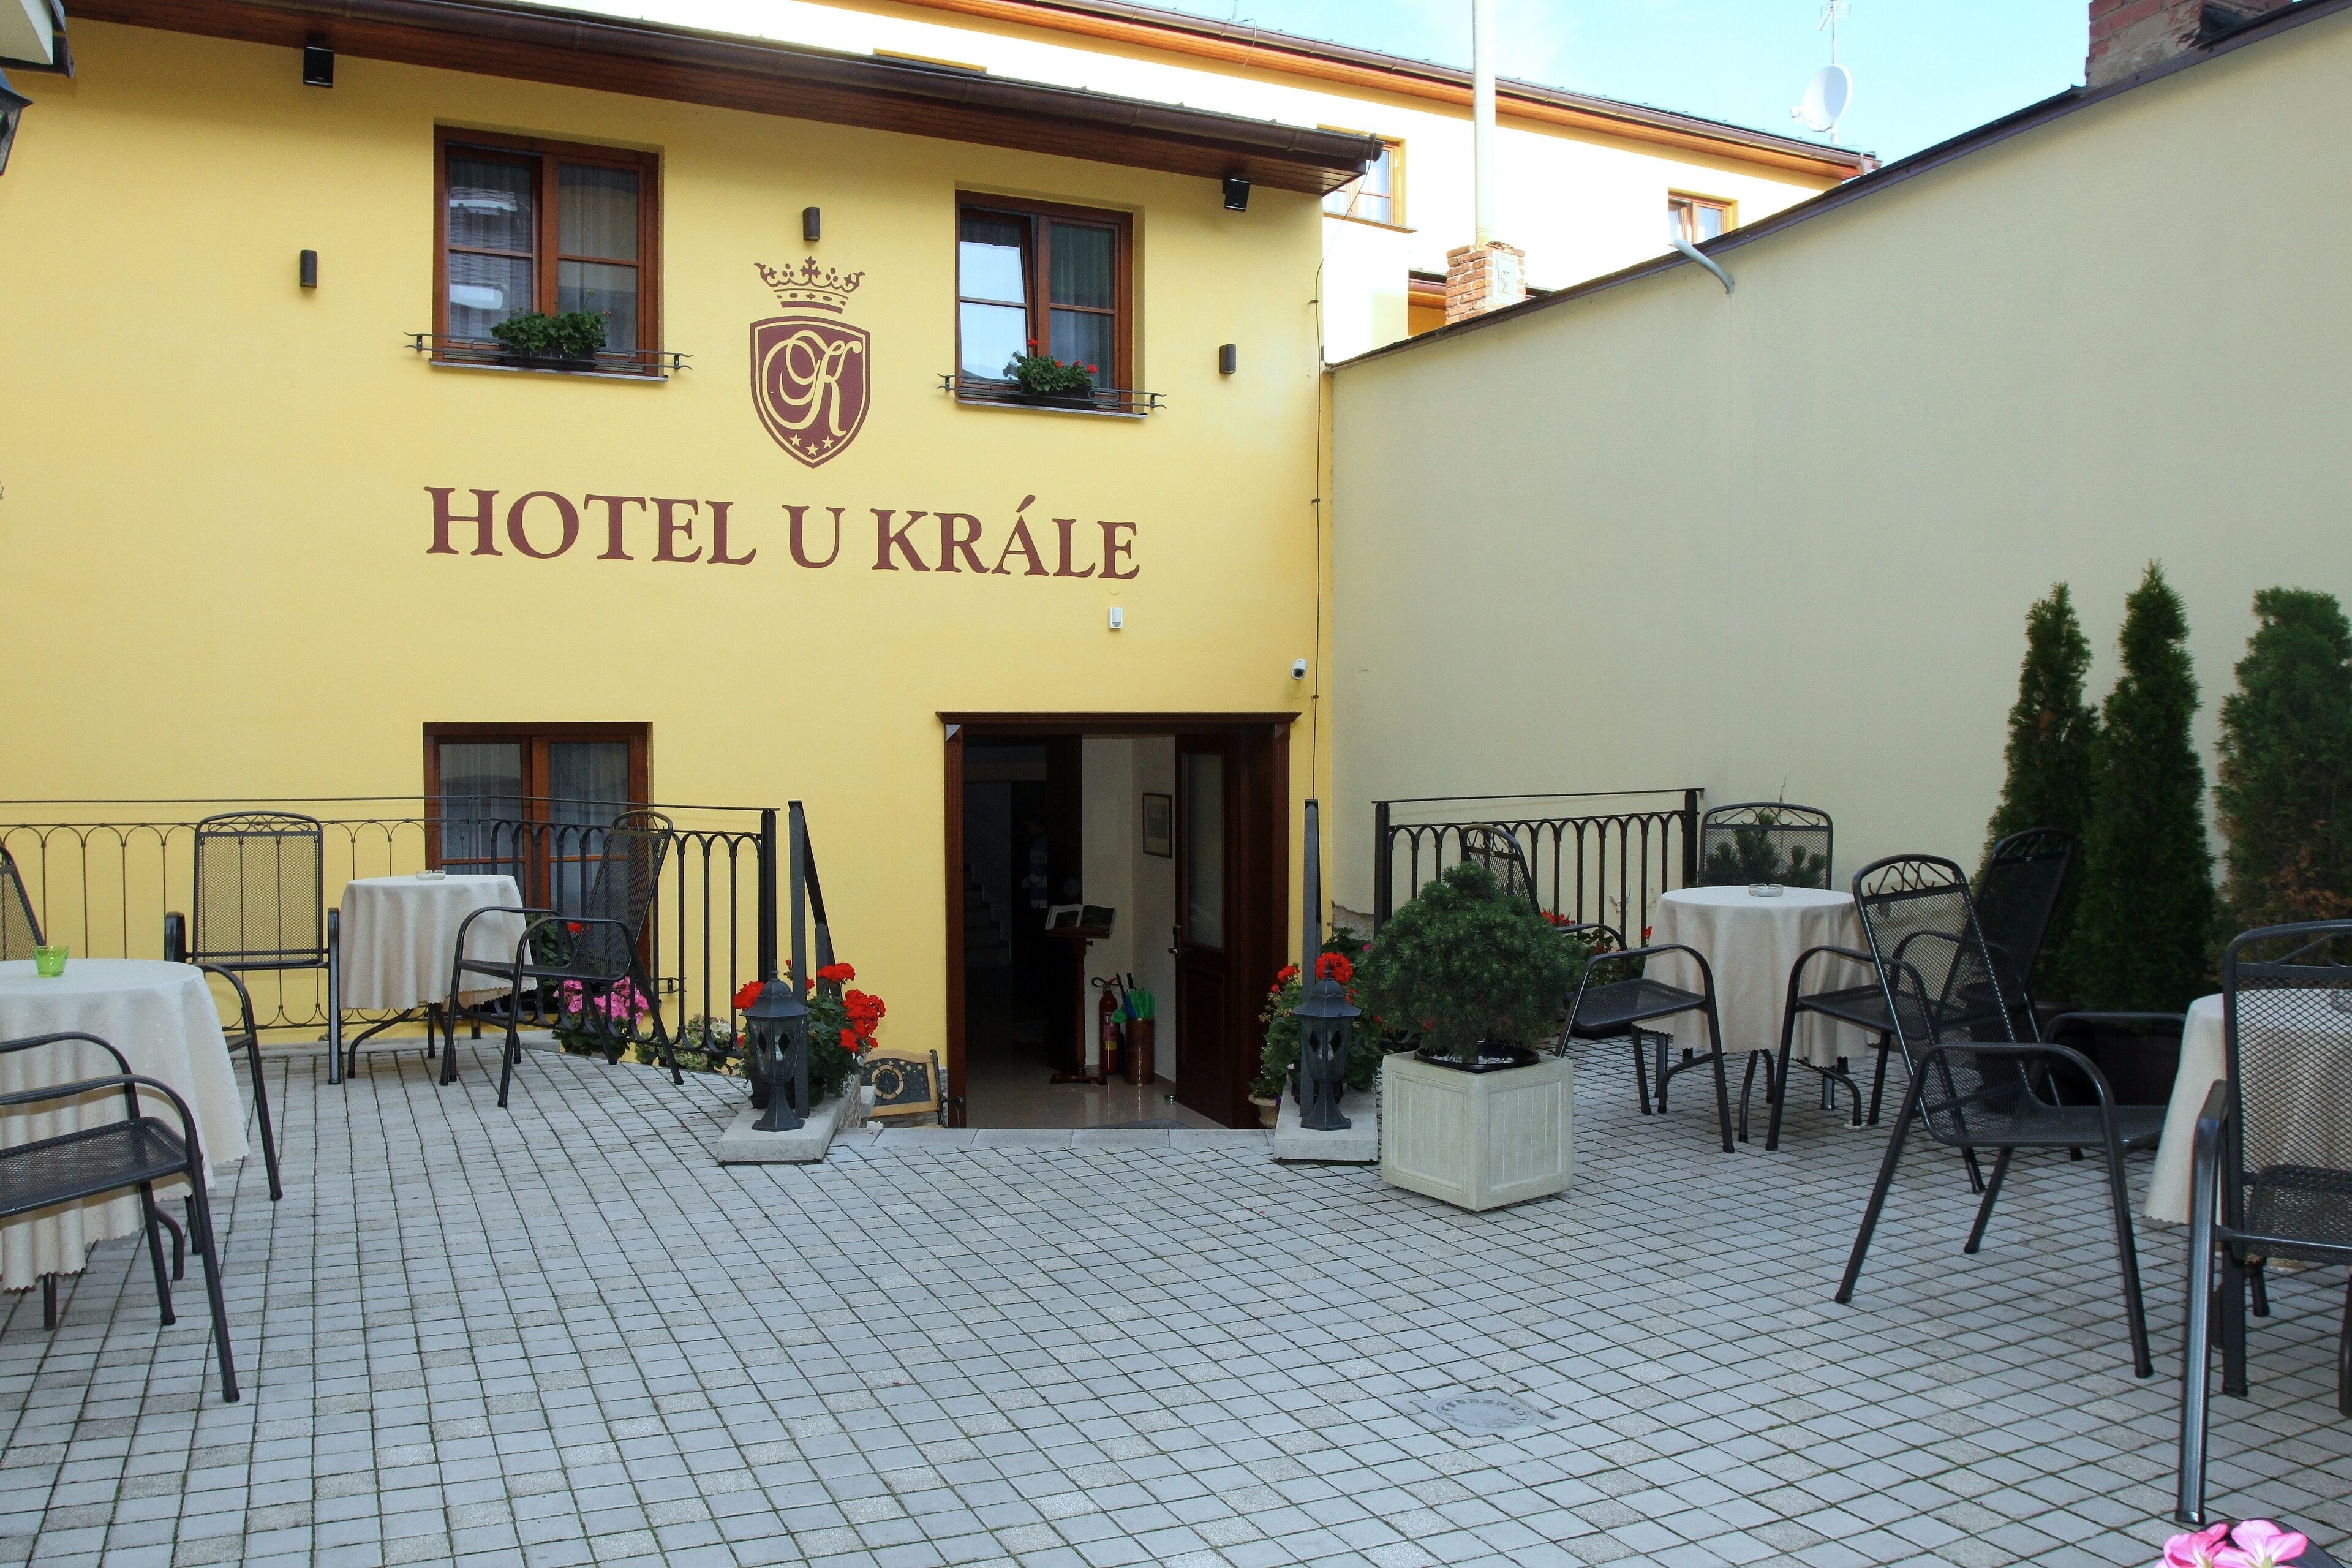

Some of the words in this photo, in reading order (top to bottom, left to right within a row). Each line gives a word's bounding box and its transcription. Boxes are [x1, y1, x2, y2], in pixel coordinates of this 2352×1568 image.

[424, 486, 756, 565] HOTEL
[783, 505, 845, 568] U
[870, 495, 1139, 579] KRÁLE
